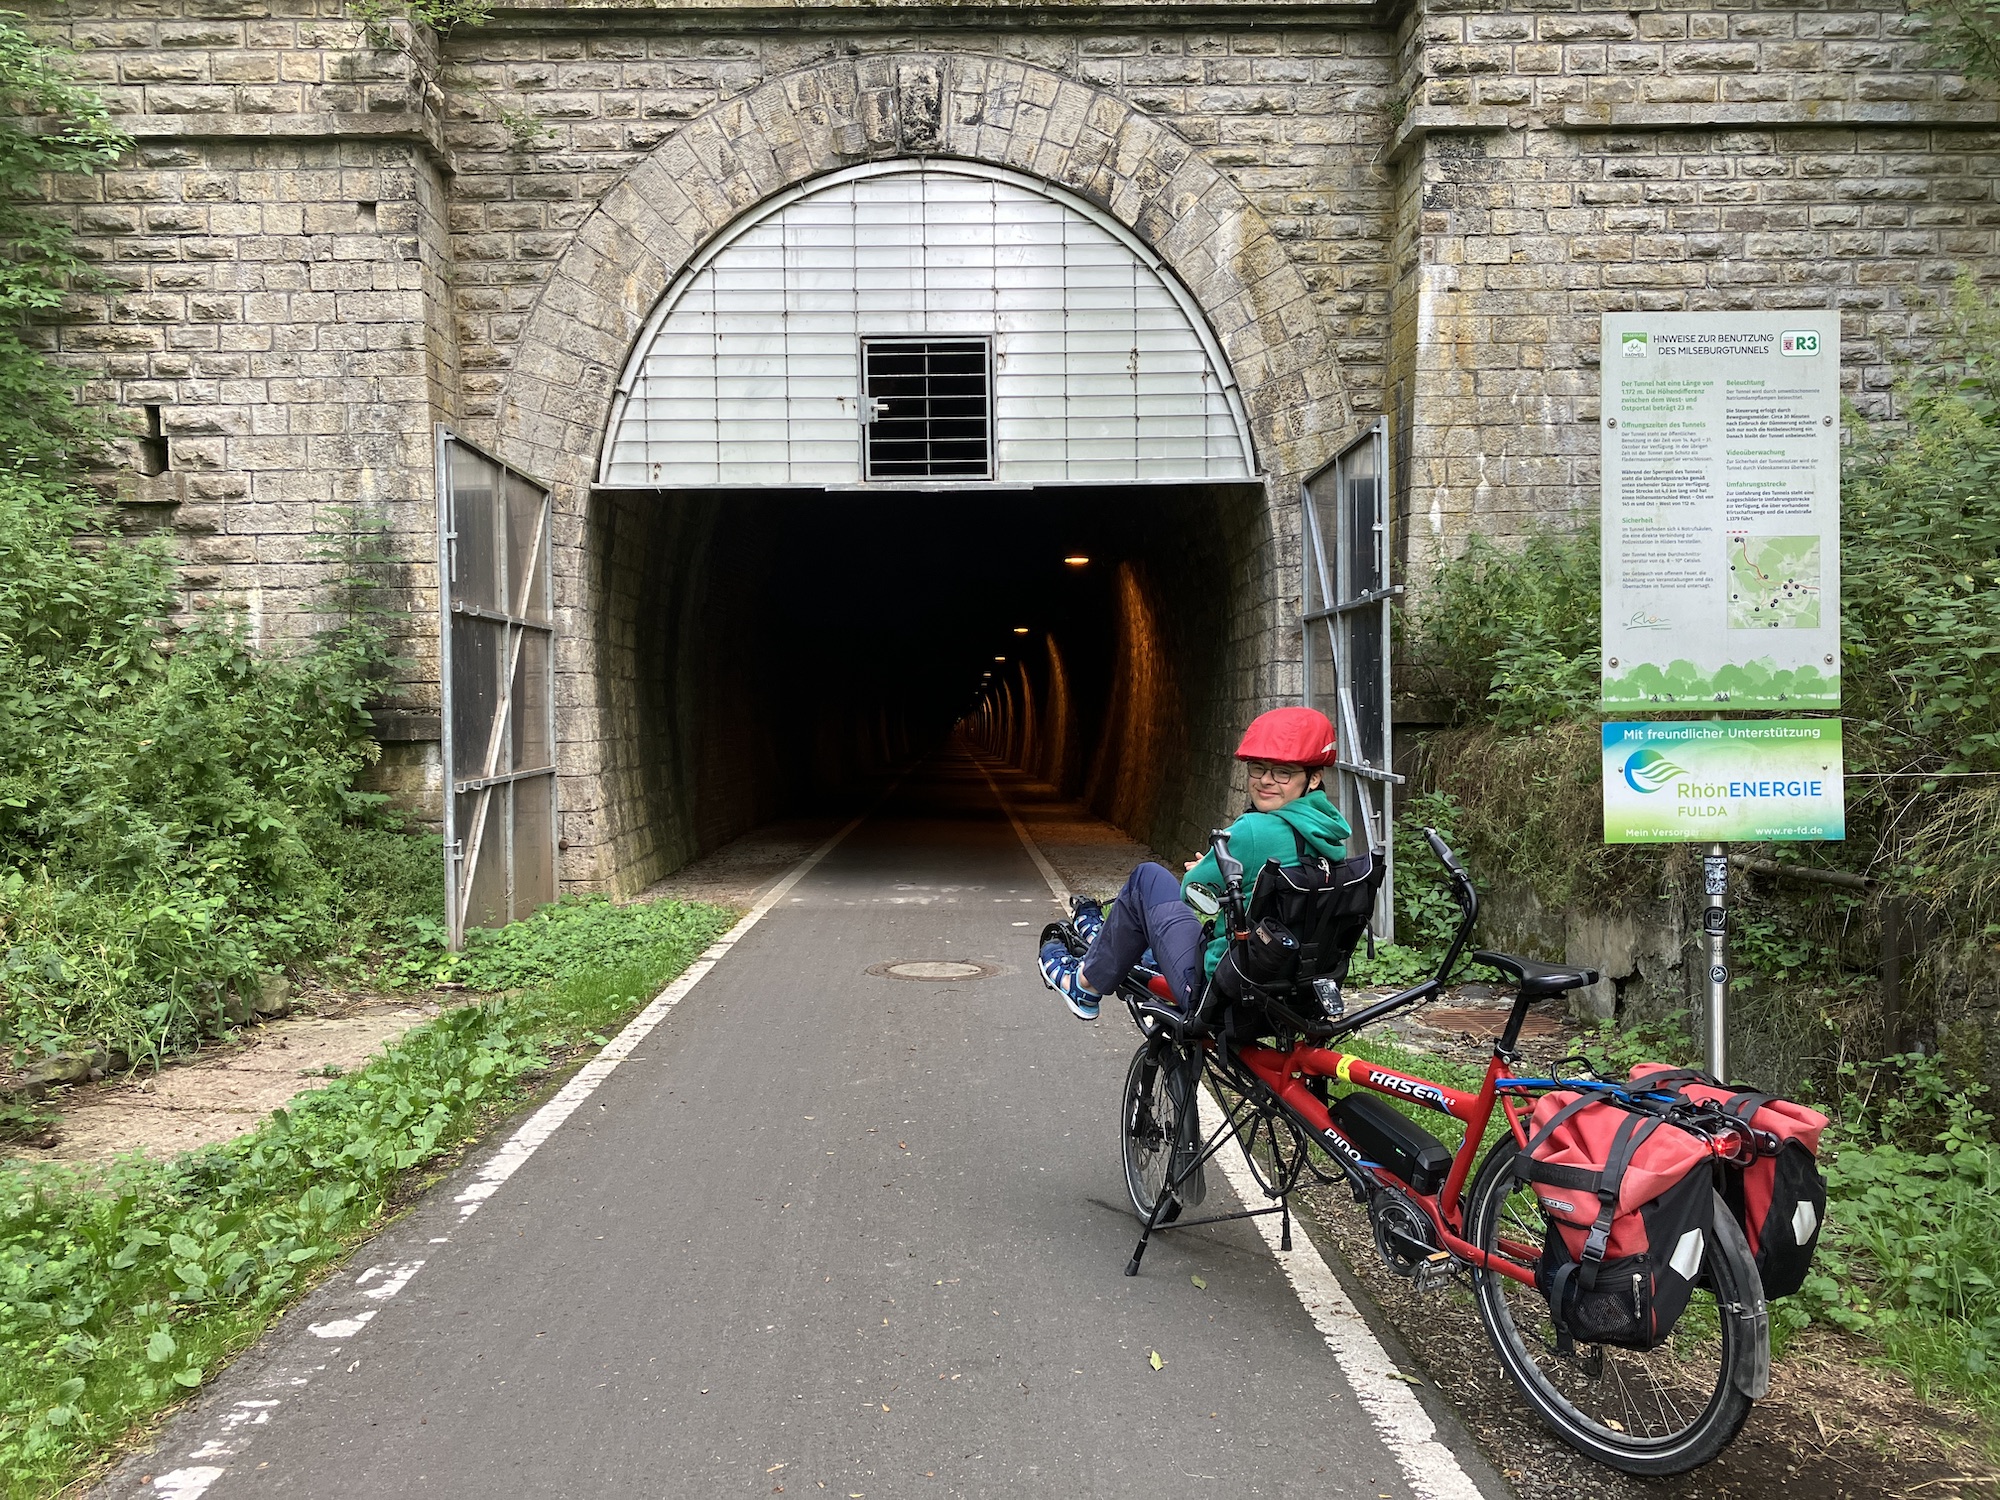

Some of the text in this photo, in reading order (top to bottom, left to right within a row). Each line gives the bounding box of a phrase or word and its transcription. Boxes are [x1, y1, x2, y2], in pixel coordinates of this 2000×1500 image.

[1654, 335, 1696, 343] HINWEISE
[1718, 334, 1774, 342] BENUTZUNG
[1796, 337, 1816, 350] R3
[1659, 346, 1769, 355] DES MILSEBURGTUNNELS
[1624, 728, 1821, 740] Mit freundlicher Unterstützung
[1678, 781, 1822, 798] RhönENERGIE
[1678, 806, 1728, 817] FULDA
[1626, 829, 1648, 837] Mein
[1756, 826, 1823, 835] www.re-fd.de
[1369, 1070, 1456, 1106] HASE BIKES
